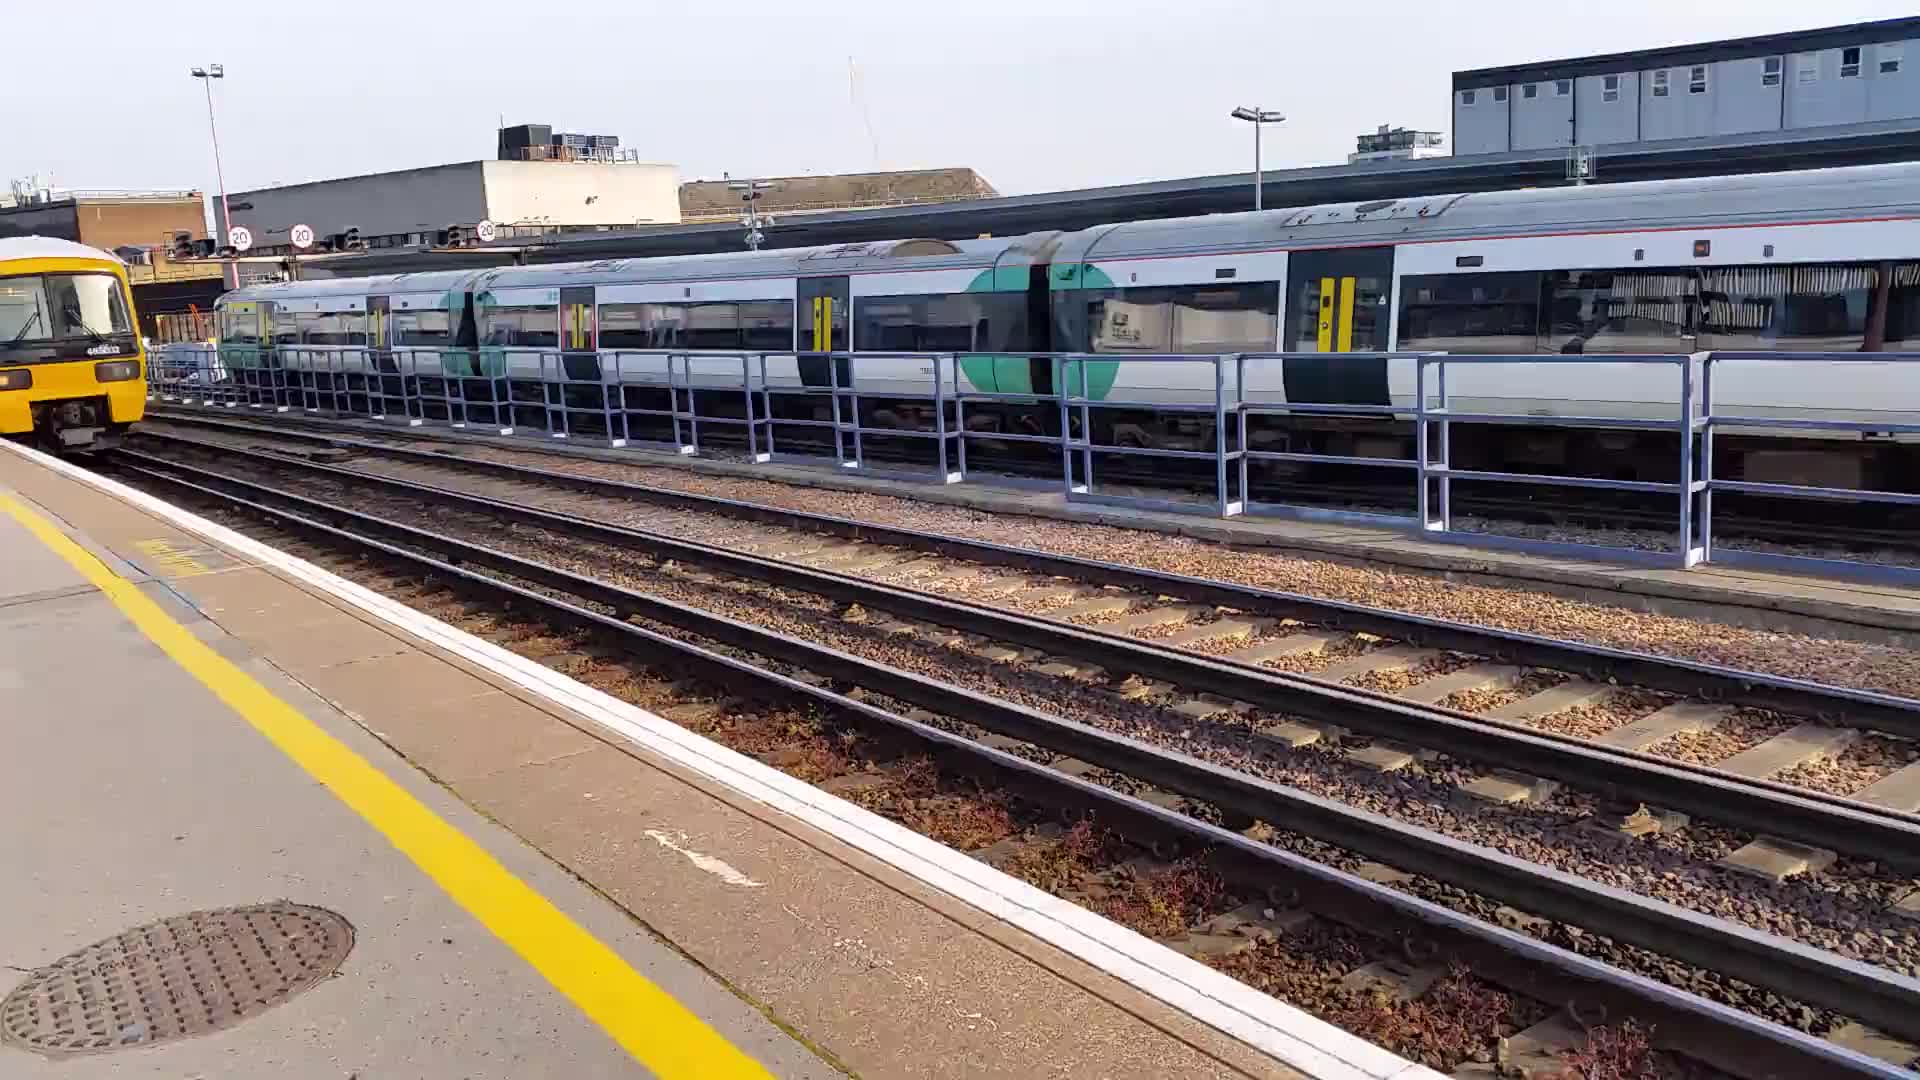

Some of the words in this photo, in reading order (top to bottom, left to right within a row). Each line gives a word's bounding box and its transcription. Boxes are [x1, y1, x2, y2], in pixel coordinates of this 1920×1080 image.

[295, 230, 309, 242] 20
[480, 224, 493, 236] 20
[233, 232, 248, 244] 20
